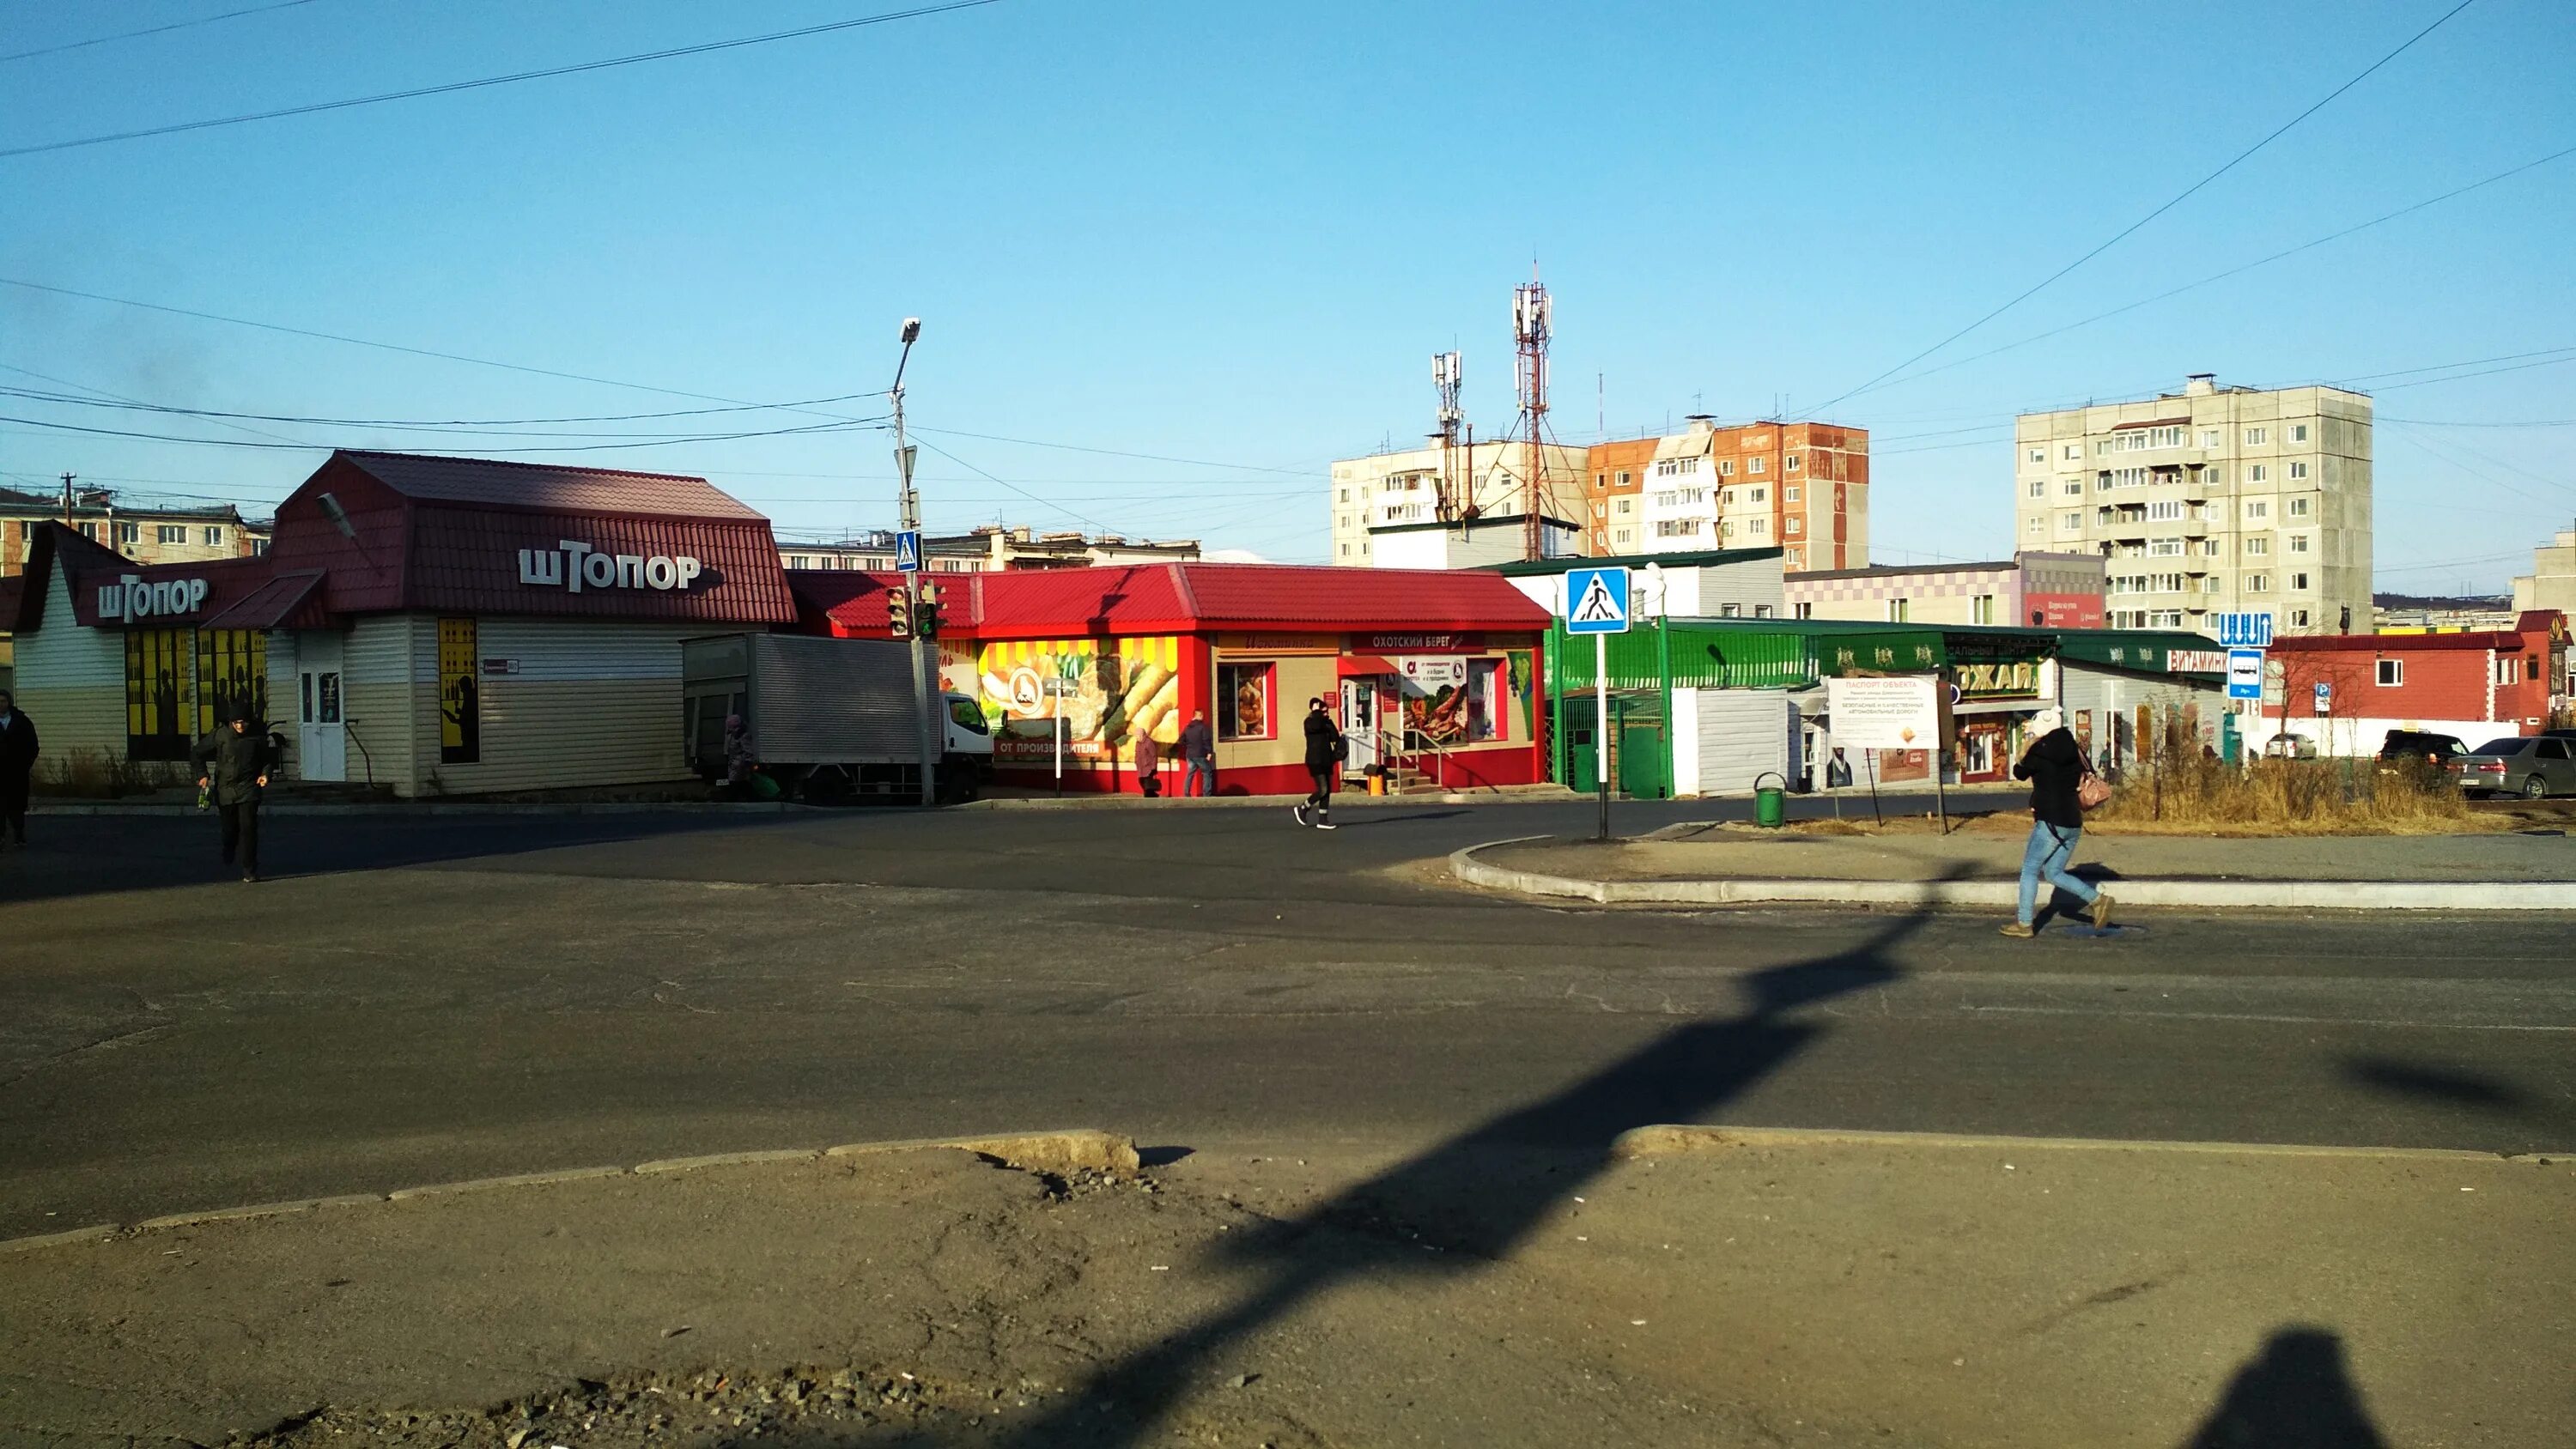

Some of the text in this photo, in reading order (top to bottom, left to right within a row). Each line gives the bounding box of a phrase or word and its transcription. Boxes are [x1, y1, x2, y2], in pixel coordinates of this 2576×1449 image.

[519, 540, 701, 593] ШТОПОР
[99, 574, 208, 623] ШТОПОР
[1374, 635, 1424, 647] ОХОТСКИЙ
[1425, 636, 1450, 647] БЕРЕГ
[1000, 743, 1012, 752] ОТ
